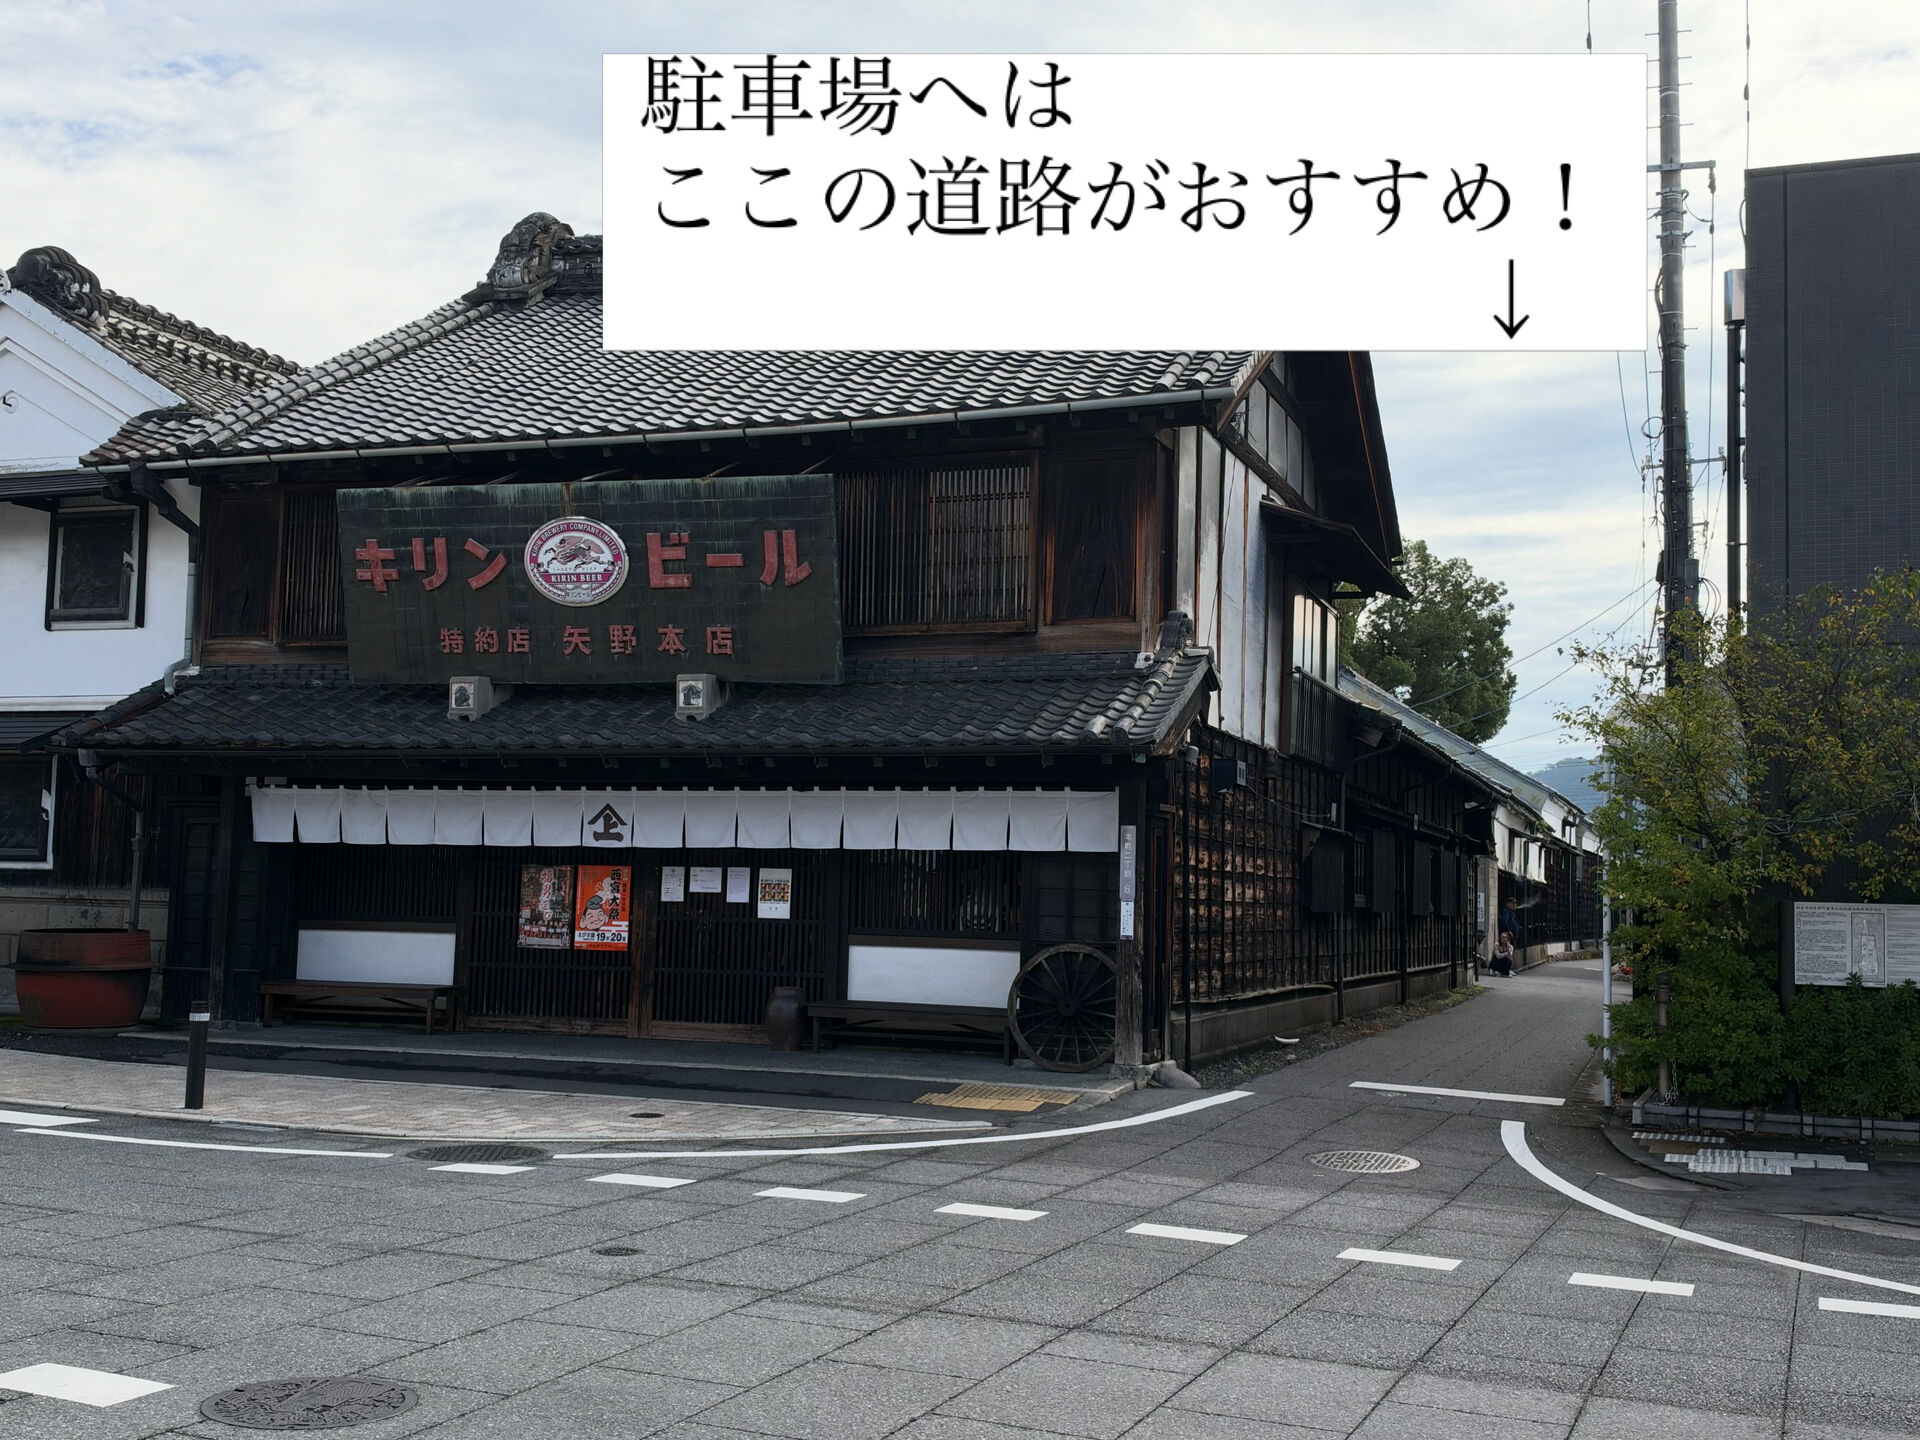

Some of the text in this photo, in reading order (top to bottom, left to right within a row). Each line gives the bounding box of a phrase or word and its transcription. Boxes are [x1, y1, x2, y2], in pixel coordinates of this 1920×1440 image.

[532, 540, 543, 557] KIRIN
[542, 523, 568, 540] BREWERY
[355, 529, 812, 592] キリン ビール
[551, 574, 603, 583] KIRIN BEER
[439, 624, 735, 656] 特約店 矢野本店
[609, 868, 622, 920] 西宮大祭
